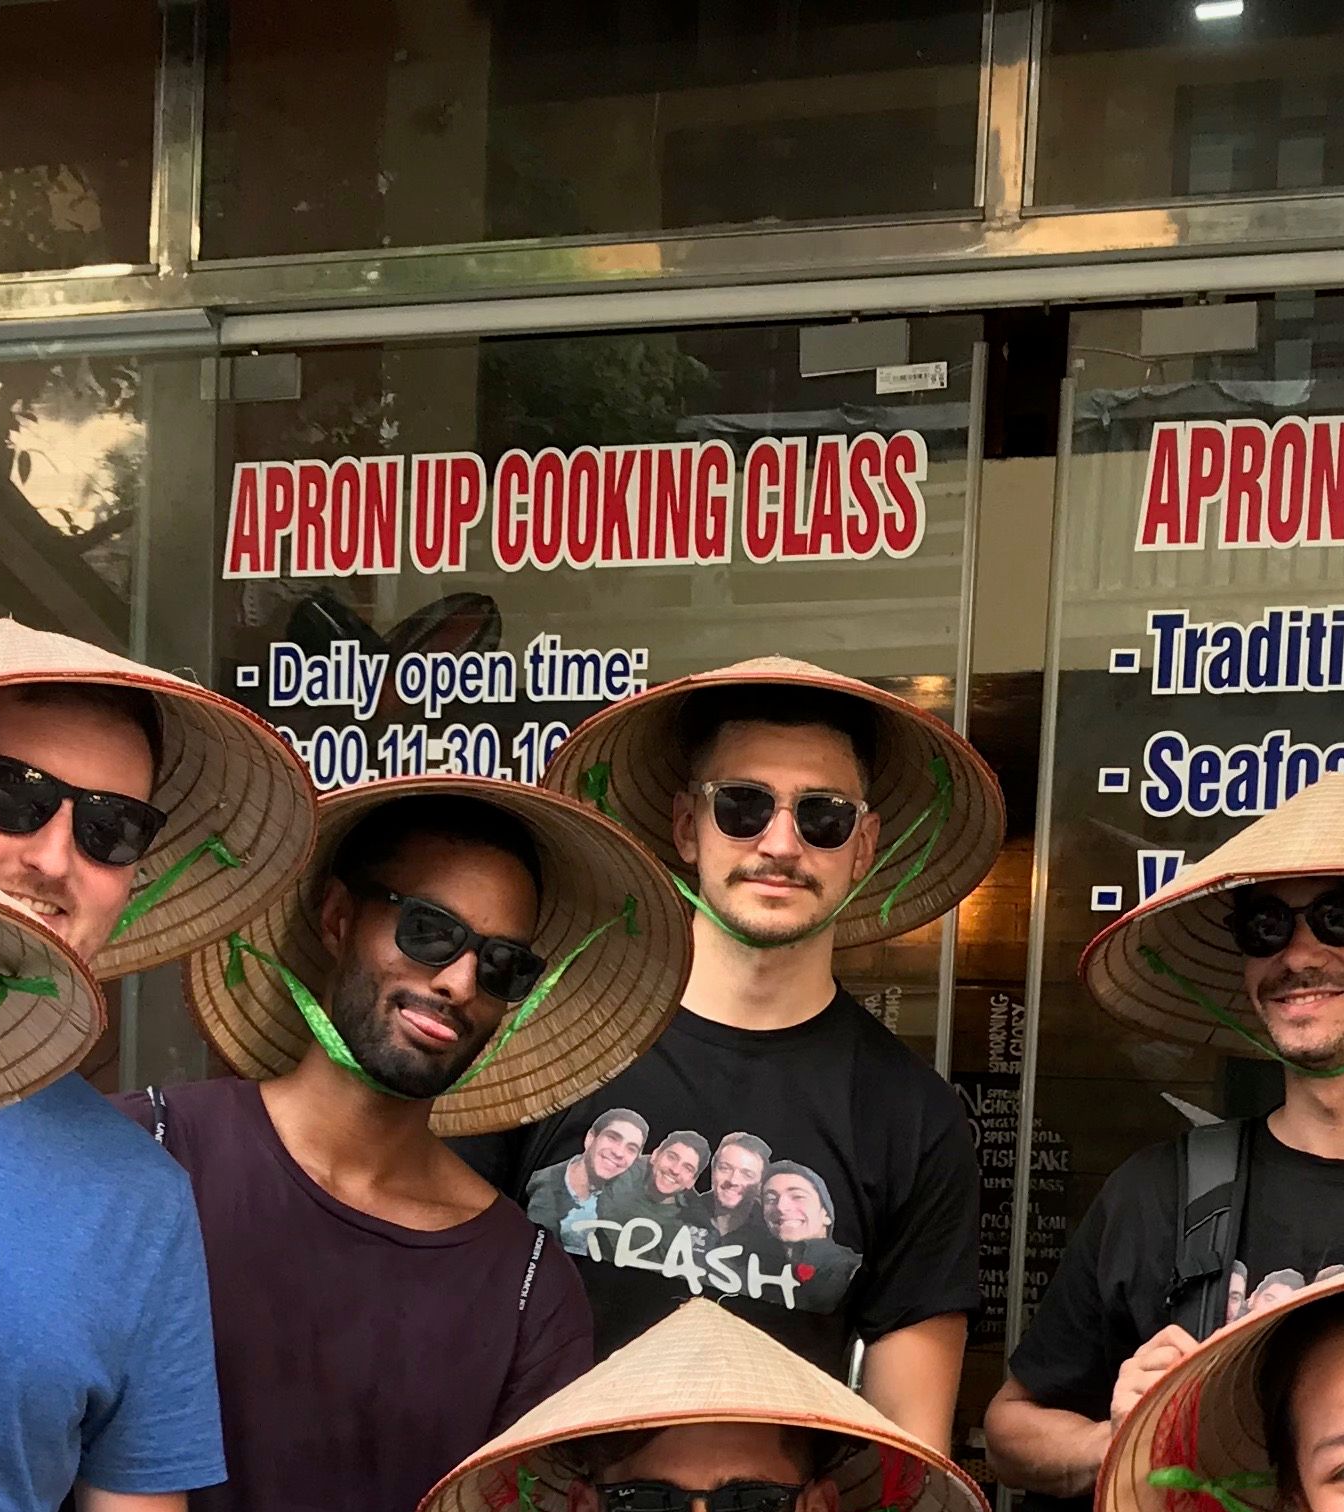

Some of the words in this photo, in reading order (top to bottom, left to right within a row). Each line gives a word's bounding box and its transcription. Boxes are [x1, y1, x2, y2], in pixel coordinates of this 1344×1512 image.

[223, 456, 406, 579] APRON
[408, 451, 486, 573] UP
[492, 439, 736, 572] COOKING
[741, 429, 928, 562] CLASS
[269, 640, 389, 721] Daily
[396, 651, 517, 719] open
[572, 1218, 800, 1309] TRASH
